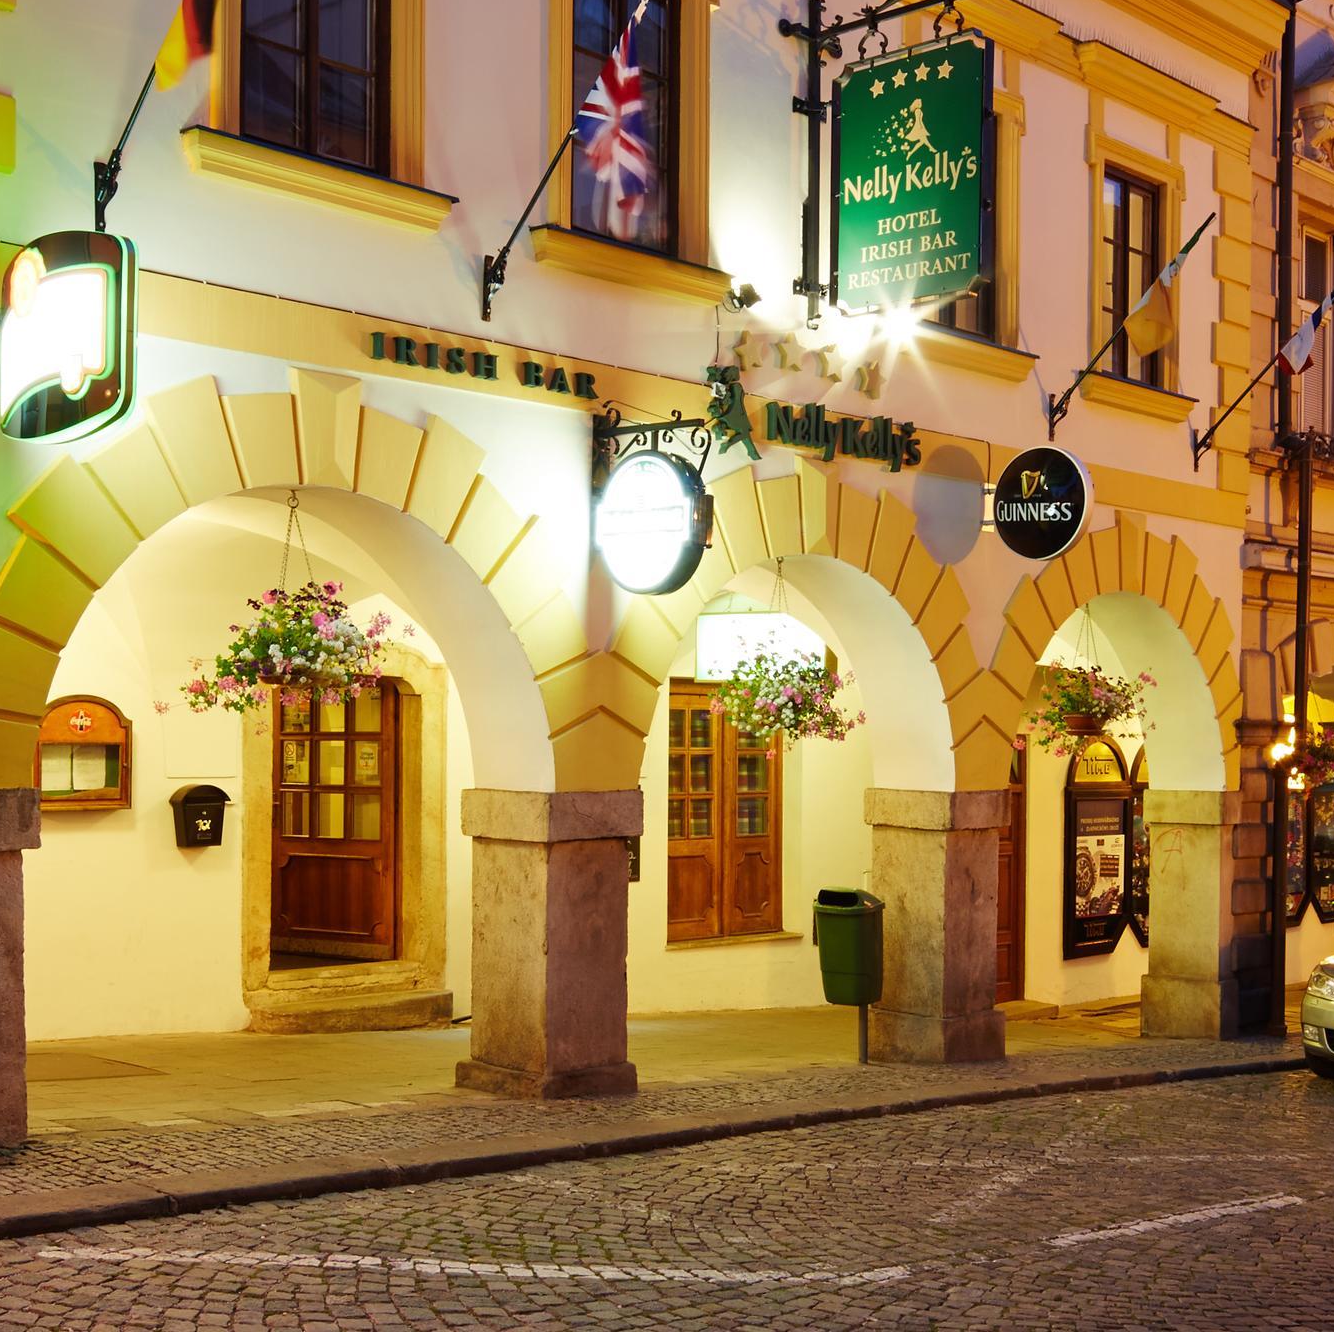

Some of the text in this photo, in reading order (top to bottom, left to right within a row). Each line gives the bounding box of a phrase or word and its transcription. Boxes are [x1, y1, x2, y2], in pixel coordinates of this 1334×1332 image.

[843, 146, 978, 205] Nelly Kelly's
[876, 208, 942, 236] HOTEL
[860, 230, 958, 264] IRISH BAR
[846, 252, 972, 291] RESTAURANT
[370, 331, 600, 400] IRISH BAR
[766, 401, 922, 472] Nelly Kelly's
[996, 500, 1073, 522] GUINNESS
